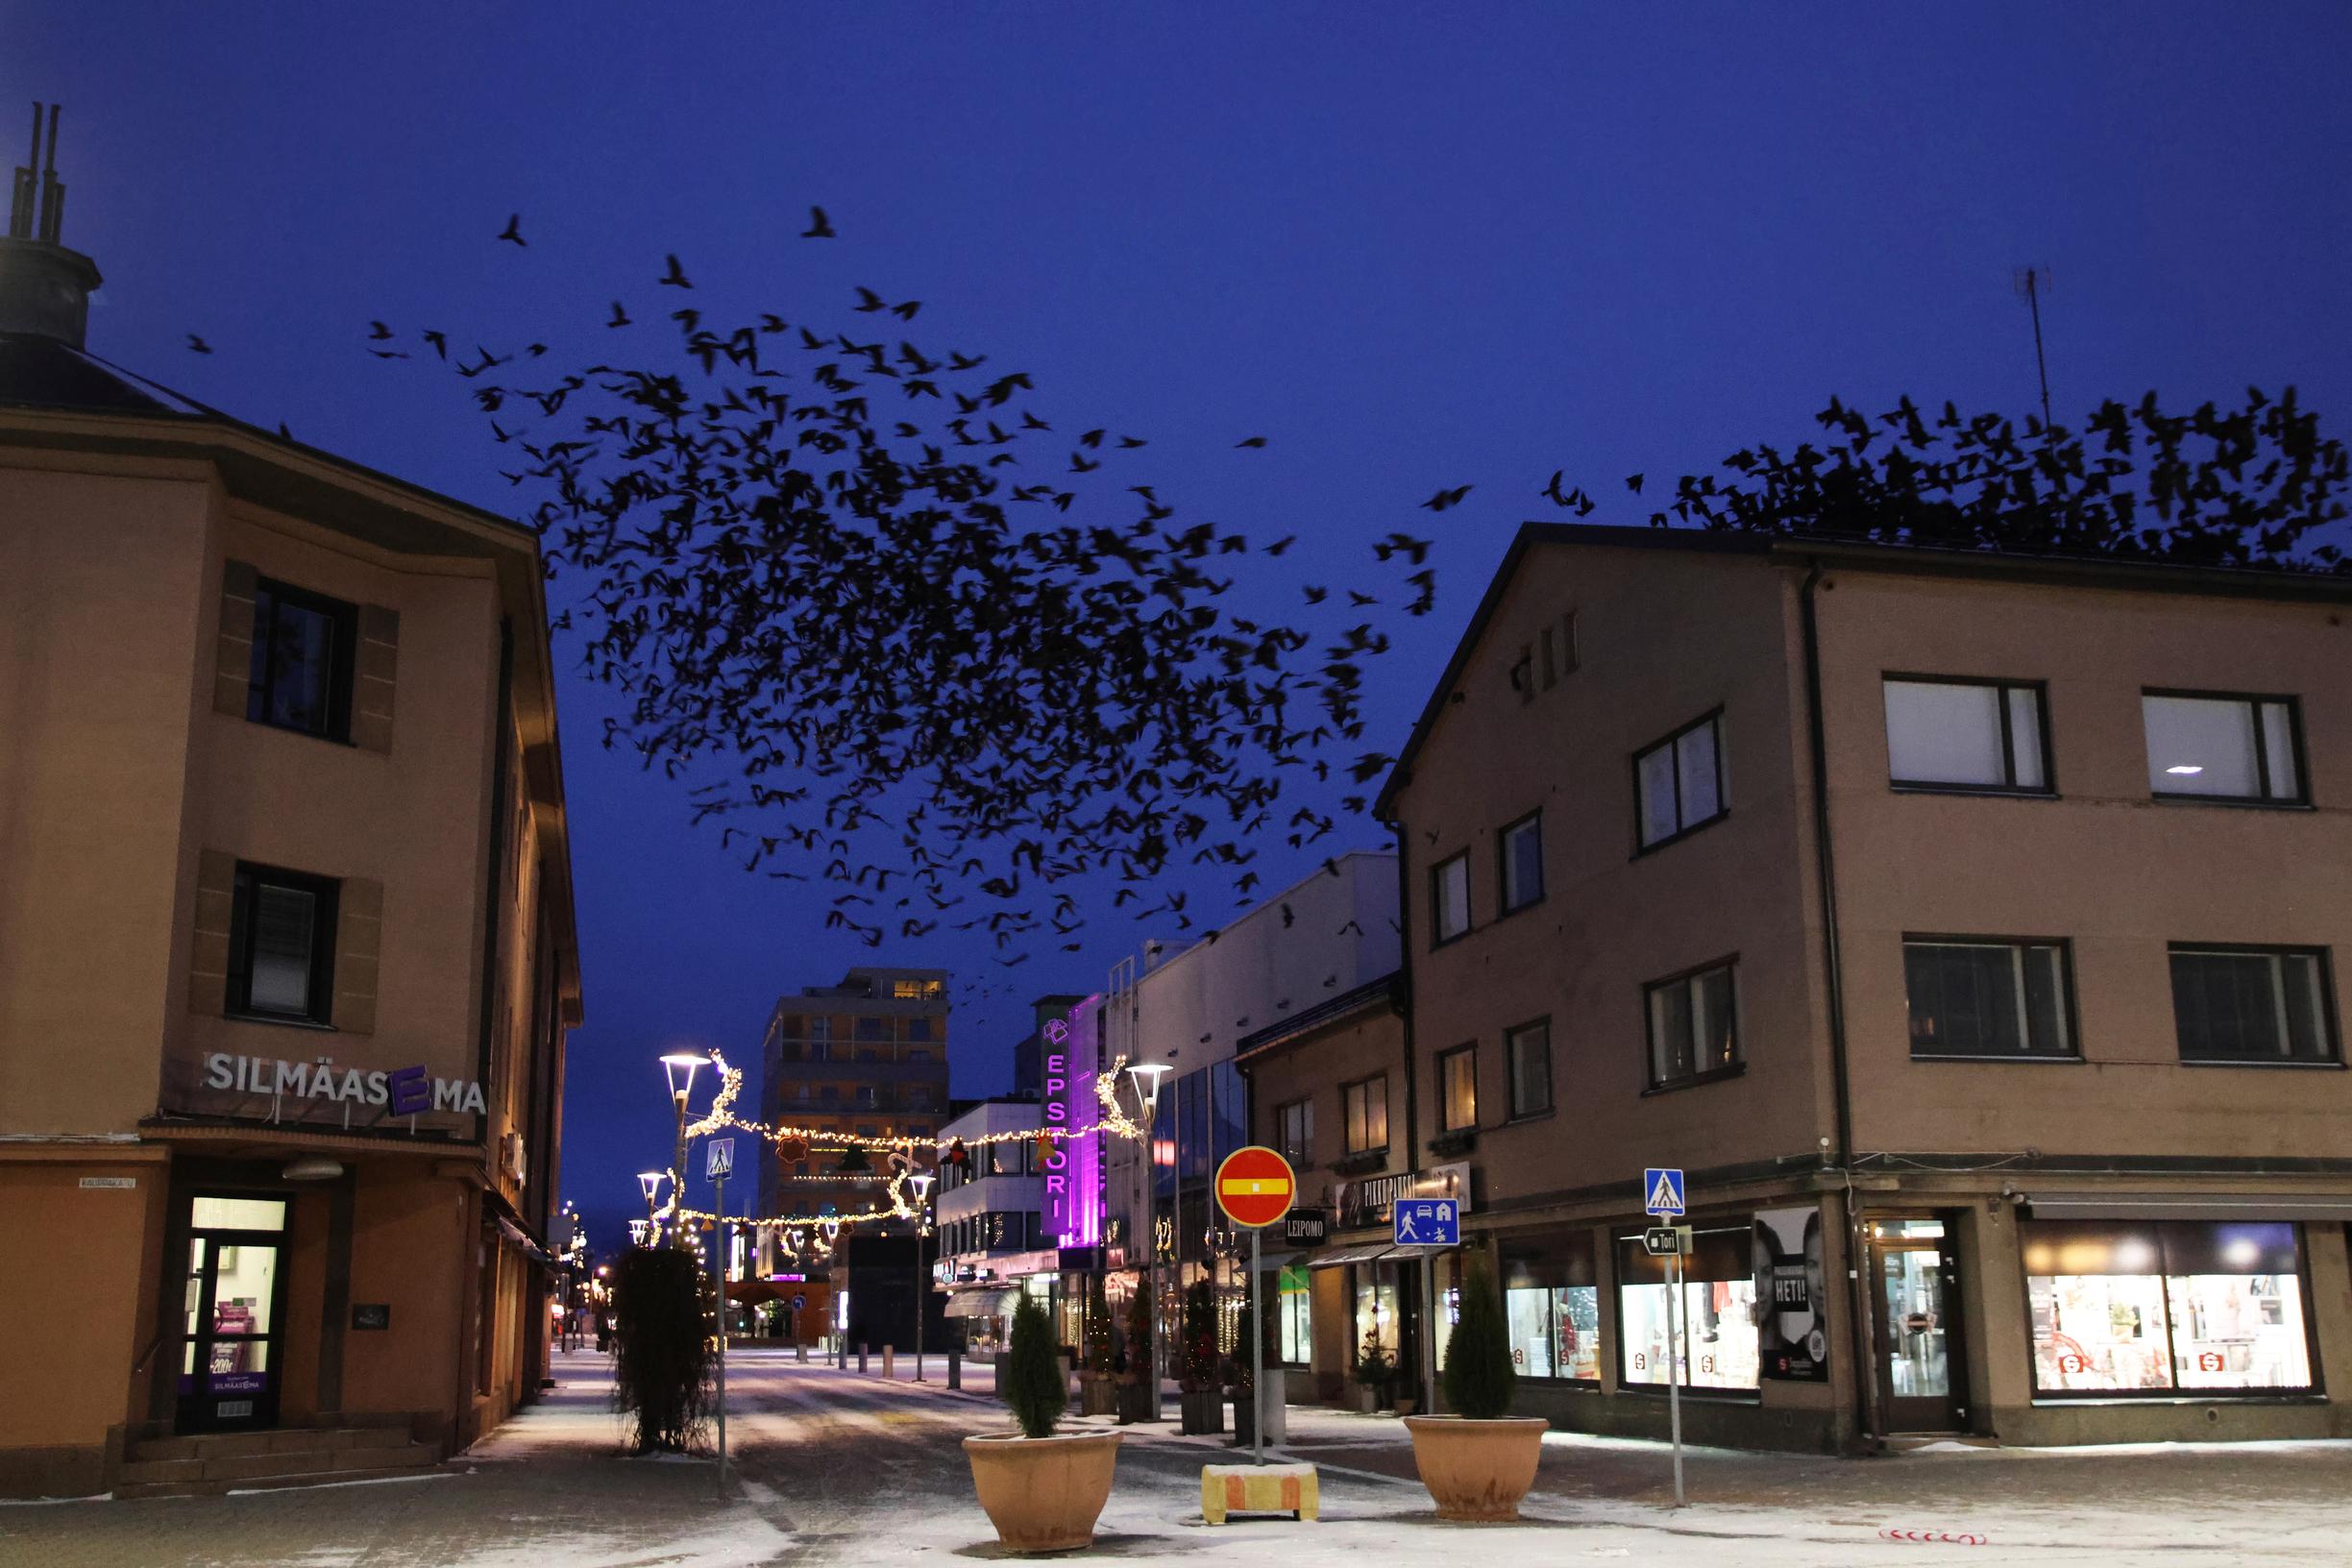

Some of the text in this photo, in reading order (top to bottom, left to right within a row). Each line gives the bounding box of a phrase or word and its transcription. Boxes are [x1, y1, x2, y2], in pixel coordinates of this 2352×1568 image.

[207, 1052, 487, 1116] SILMÄASEMA
[1045, 1055, 1067, 1217] EPSTORI
[1364, 1173, 1416, 1207] PIKKU PAUSSI
[1286, 1220, 1324, 1237] LEIPOMO
[1659, 1234, 1676, 1249] Tori
[1775, 1279, 1806, 1301] HETI!
